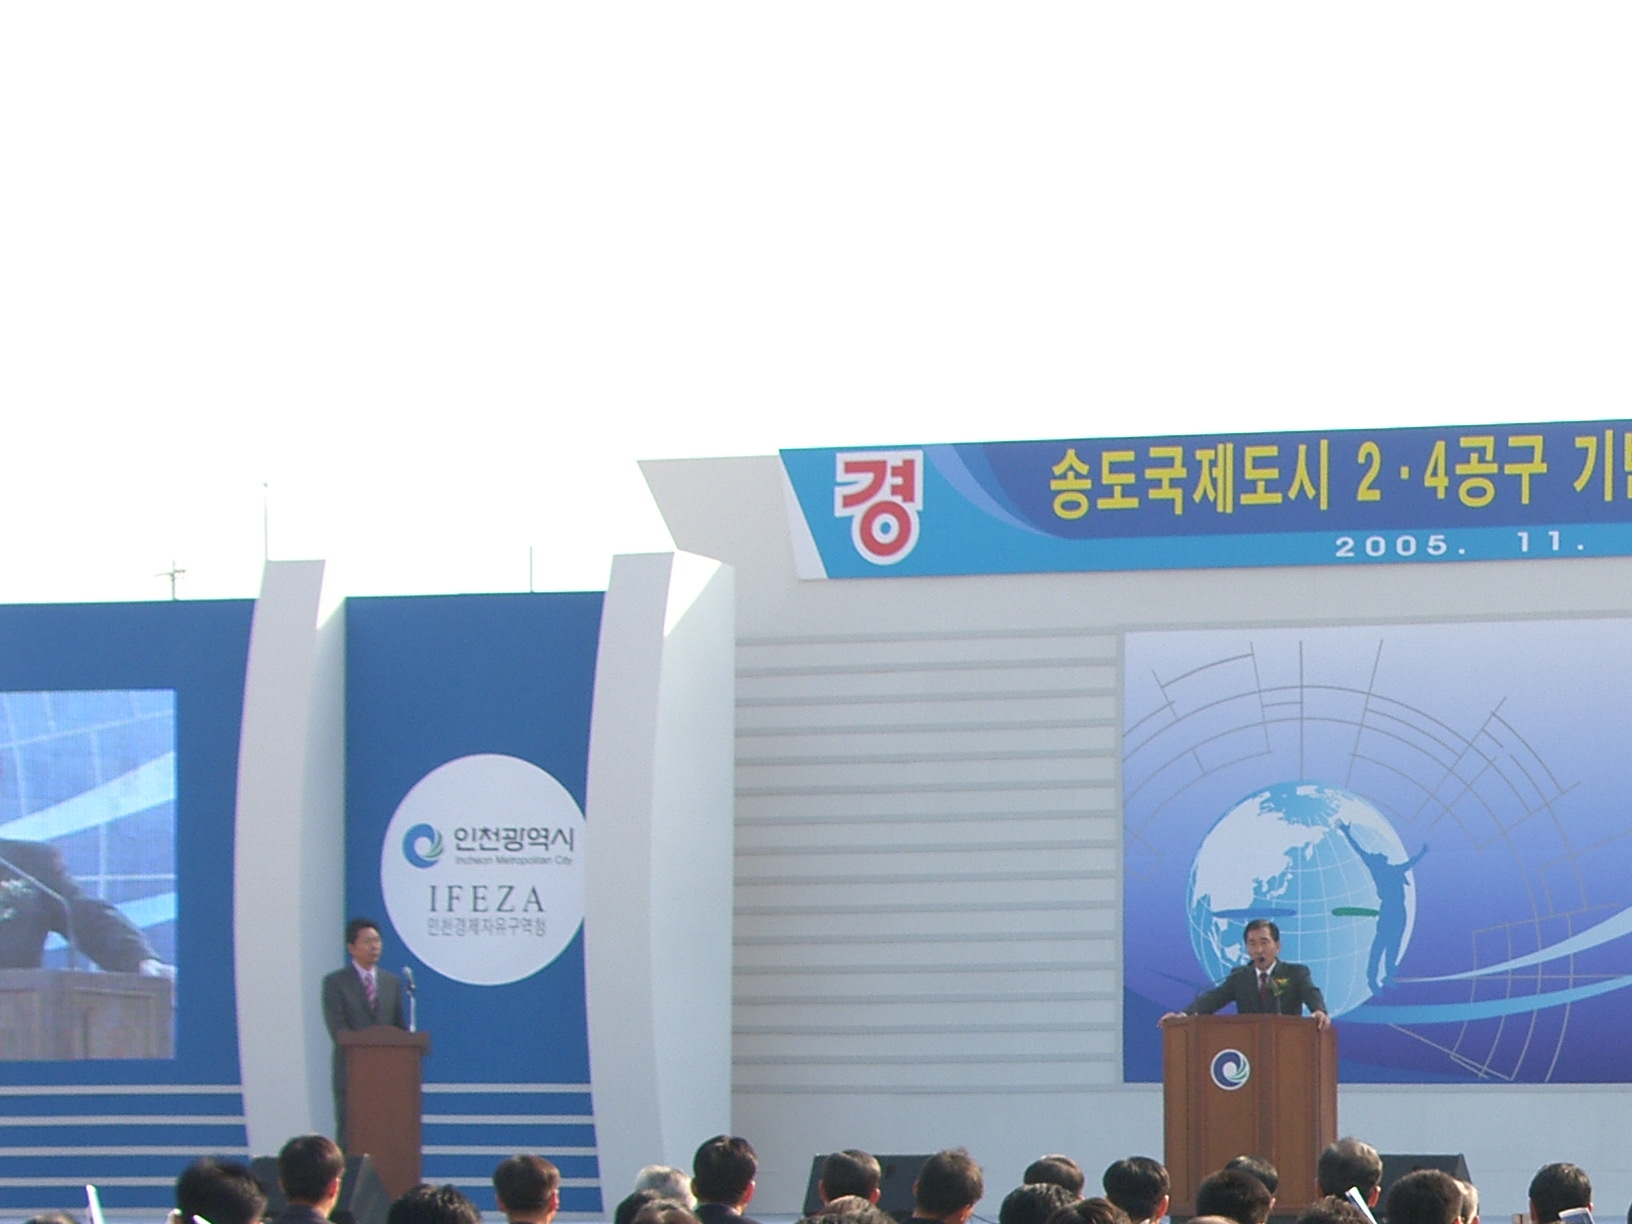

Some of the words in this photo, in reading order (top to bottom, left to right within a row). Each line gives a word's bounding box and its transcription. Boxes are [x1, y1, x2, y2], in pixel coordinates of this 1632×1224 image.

[1050, 439, 1330, 519] 송도국제도시
[837, 452, 921, 564] 경
[1336, 535, 1467, 557] 2005.
[1517, 530, 1583, 551] 11.
[454, 826, 574, 852] 인천광역시
[455, 855, 493, 865] Incheon
[496, 855, 552, 866] Metropolitan
[555, 855, 573, 866] City
[429, 884, 545, 912] IFEZA
